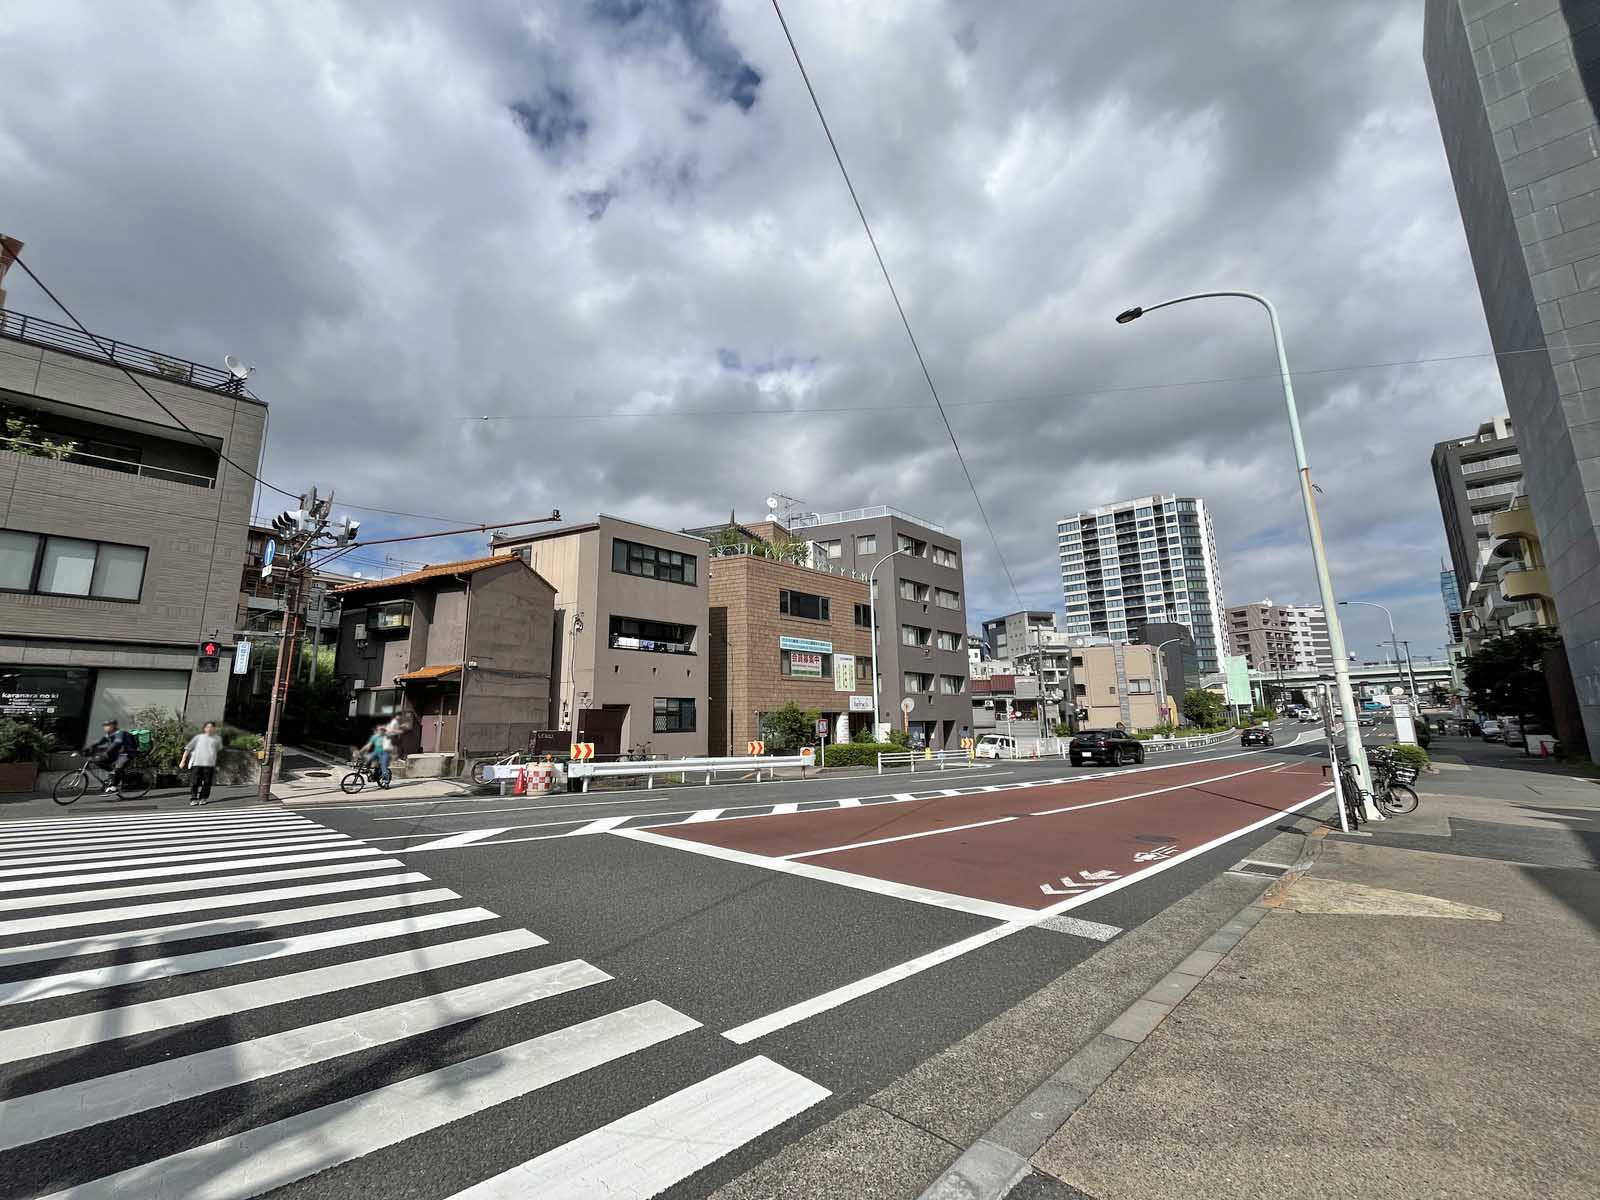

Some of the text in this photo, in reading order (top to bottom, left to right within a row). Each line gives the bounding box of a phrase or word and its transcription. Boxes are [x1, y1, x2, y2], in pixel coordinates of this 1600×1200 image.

[791, 651, 820, 664] 会員募集中
